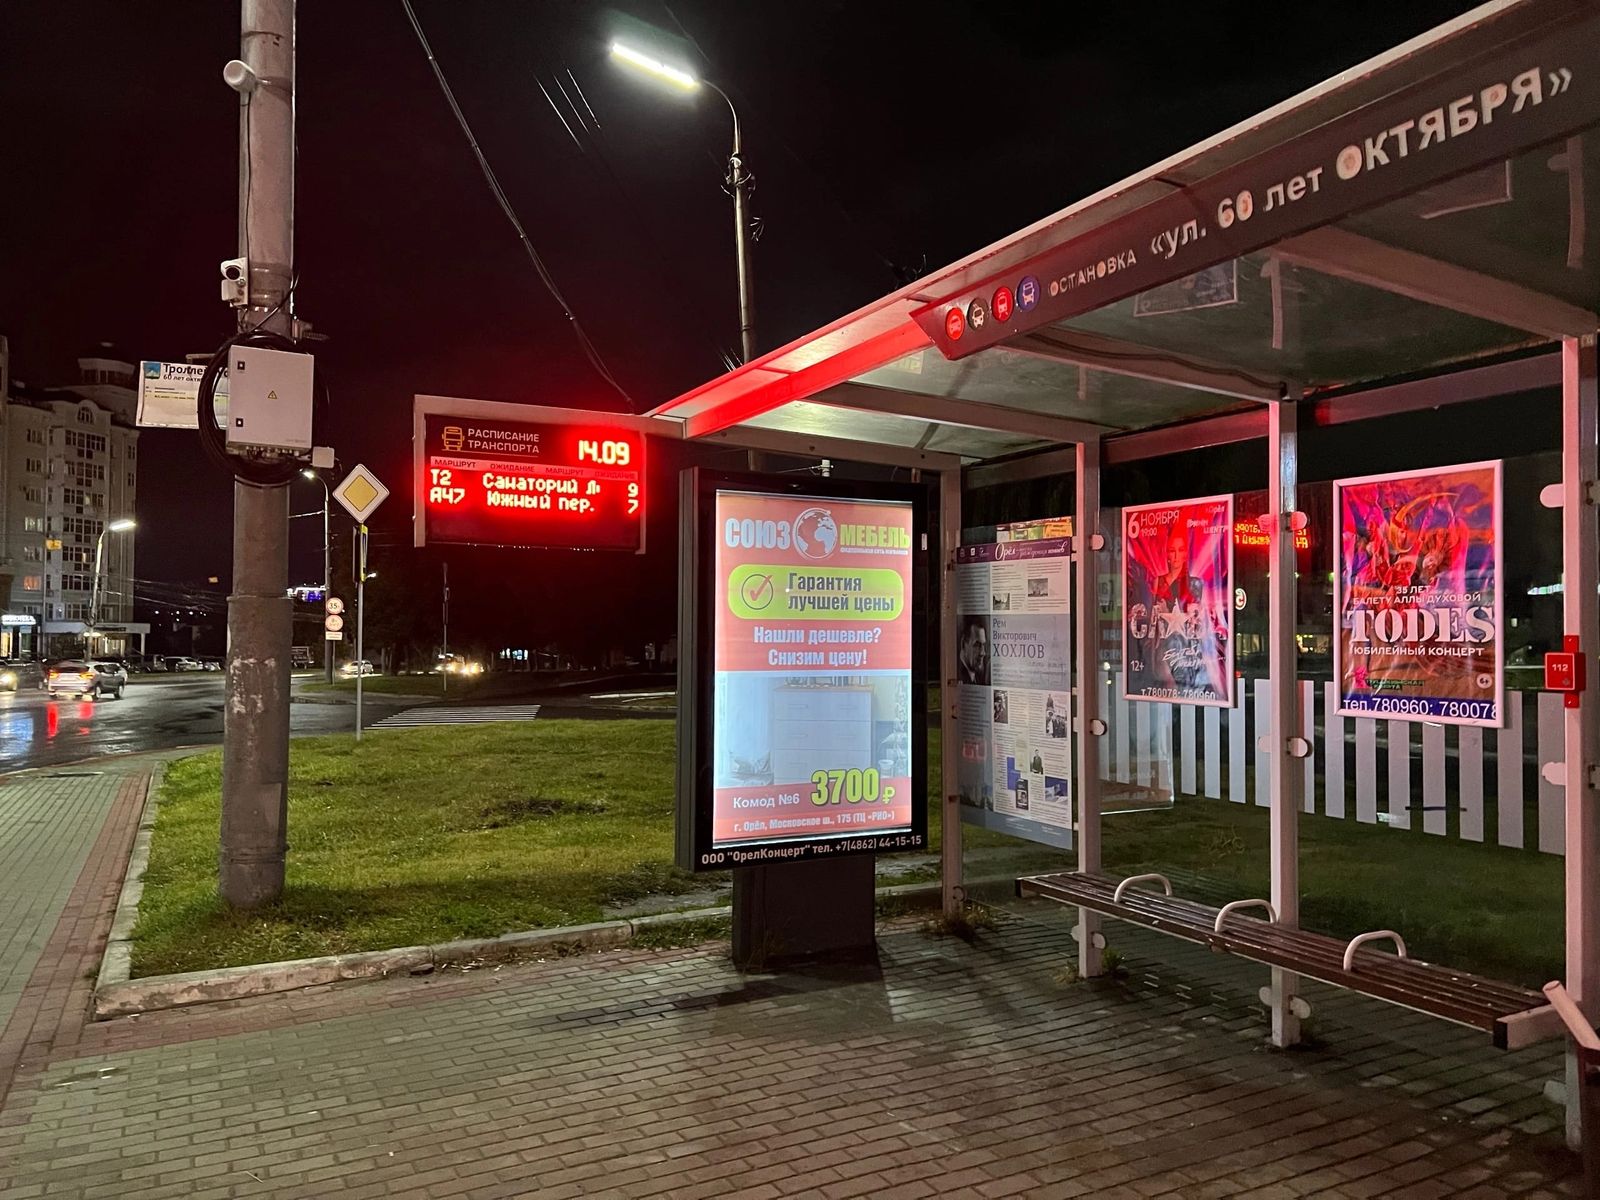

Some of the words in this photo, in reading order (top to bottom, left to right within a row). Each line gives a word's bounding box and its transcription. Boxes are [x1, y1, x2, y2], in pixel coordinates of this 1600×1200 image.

[1048, 249, 1137, 297] ОСТАНОВКА
[1216, 189, 1254, 230] 60
[1262, 166, 1323, 213] лет
[1336, 66, 1573, 181] ОКТЯБРЯ»
[467, 428, 540, 443] РАСПИСАНИЕ
[467, 439, 540, 454] ТРАНСПОРТА
[578, 439, 631, 466] 14.09
[434, 459, 477, 469] МАРШРУТ
[490, 463, 536, 473] ОЖИДАНИЕ
[545, 467, 584, 476] МАРШРУТ
[482, 472, 578, 494] Санаторий
[627, 482, 639, 498] 9
[486, 490, 551, 510] Южный
[558, 496, 596, 514] пер.
[627, 498, 639, 514] 7
[1127, 512, 1141, 539] 6
[1140, 510, 1180, 527] НОЯБРЯ
[725, 517, 791, 550] СОЮЗ
[840, 524, 910, 549] МЕБЕЛЬ
[788, 573, 862, 592] Гарантия
[1397, 586, 1407, 594] 35
[1410, 585, 1430, 594] ЛЕТ
[788, 593, 849, 612] лучшей
[854, 597, 894, 613] цены
[1353, 597, 1392, 606] БАЛЕТУ
[1394, 595, 1424, 605] АЛЛЫ
[1426, 592, 1481, 604] ДУХОВОЙ
[1346, 606, 1495, 643] TODES
[753, 626, 804, 644] Нашли
[808, 627, 882, 644] дешевле?
[992, 631, 1037, 642] Викторович
[768, 649, 825, 666] Снизим
[829, 649, 868, 667] цену!
[993, 643, 1045, 659] ХОХЛОВ
[1354, 645, 1426, 656] ЮБИЛЕЙНЫЙ
[1428, 647, 1485, 657] КОНЦЕРТ
[1130, 660, 1145, 672] 12+
[1551, 663, 1569, 672] 112
[733, 797, 775, 809] Комод
[778, 793, 800, 805] №6
[811, 768, 880, 806] 3700
[769, 818, 821, 831] Московское
[837, 814, 851, 823] 175
[702, 853, 725, 865] ООО
[727, 844, 810, 863] "ОрелКонцерт"
[812, 844, 833, 854] тел.
[879, 835, 922, 848] 44-15-15
